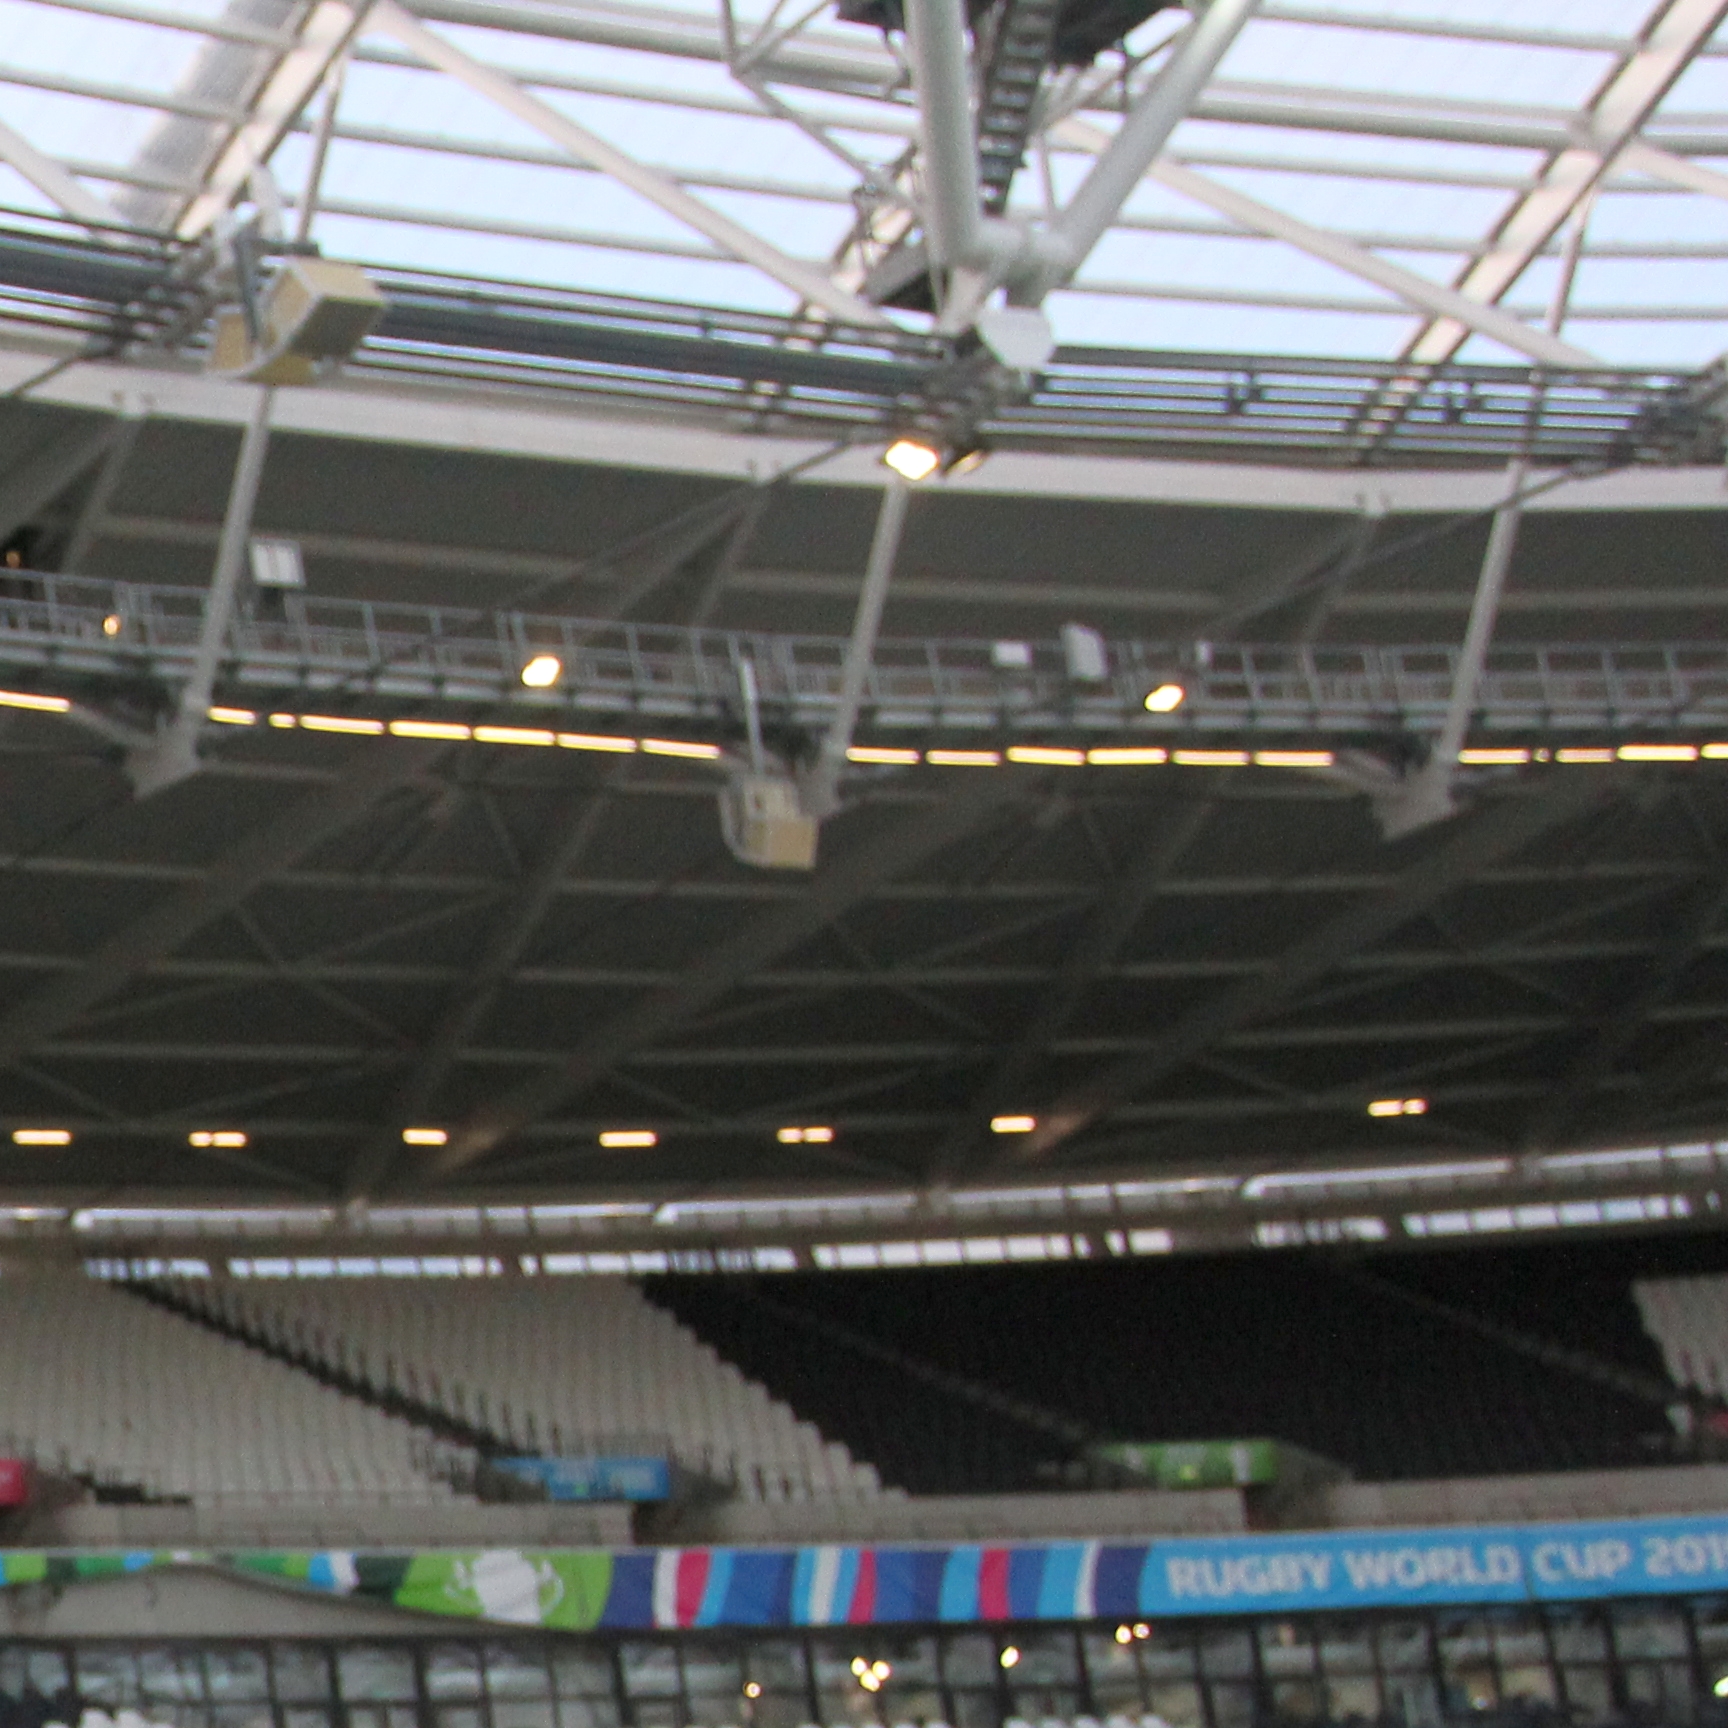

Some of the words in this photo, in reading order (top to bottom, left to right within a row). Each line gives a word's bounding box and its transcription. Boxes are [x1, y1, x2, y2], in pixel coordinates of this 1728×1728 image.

[1166, 1553, 1332, 1599] RUGBY
[1344, 1543, 1523, 1589] WORLD
[1531, 1538, 1631, 1582] CUP
[1643, 1531, 1728, 1577] 201
